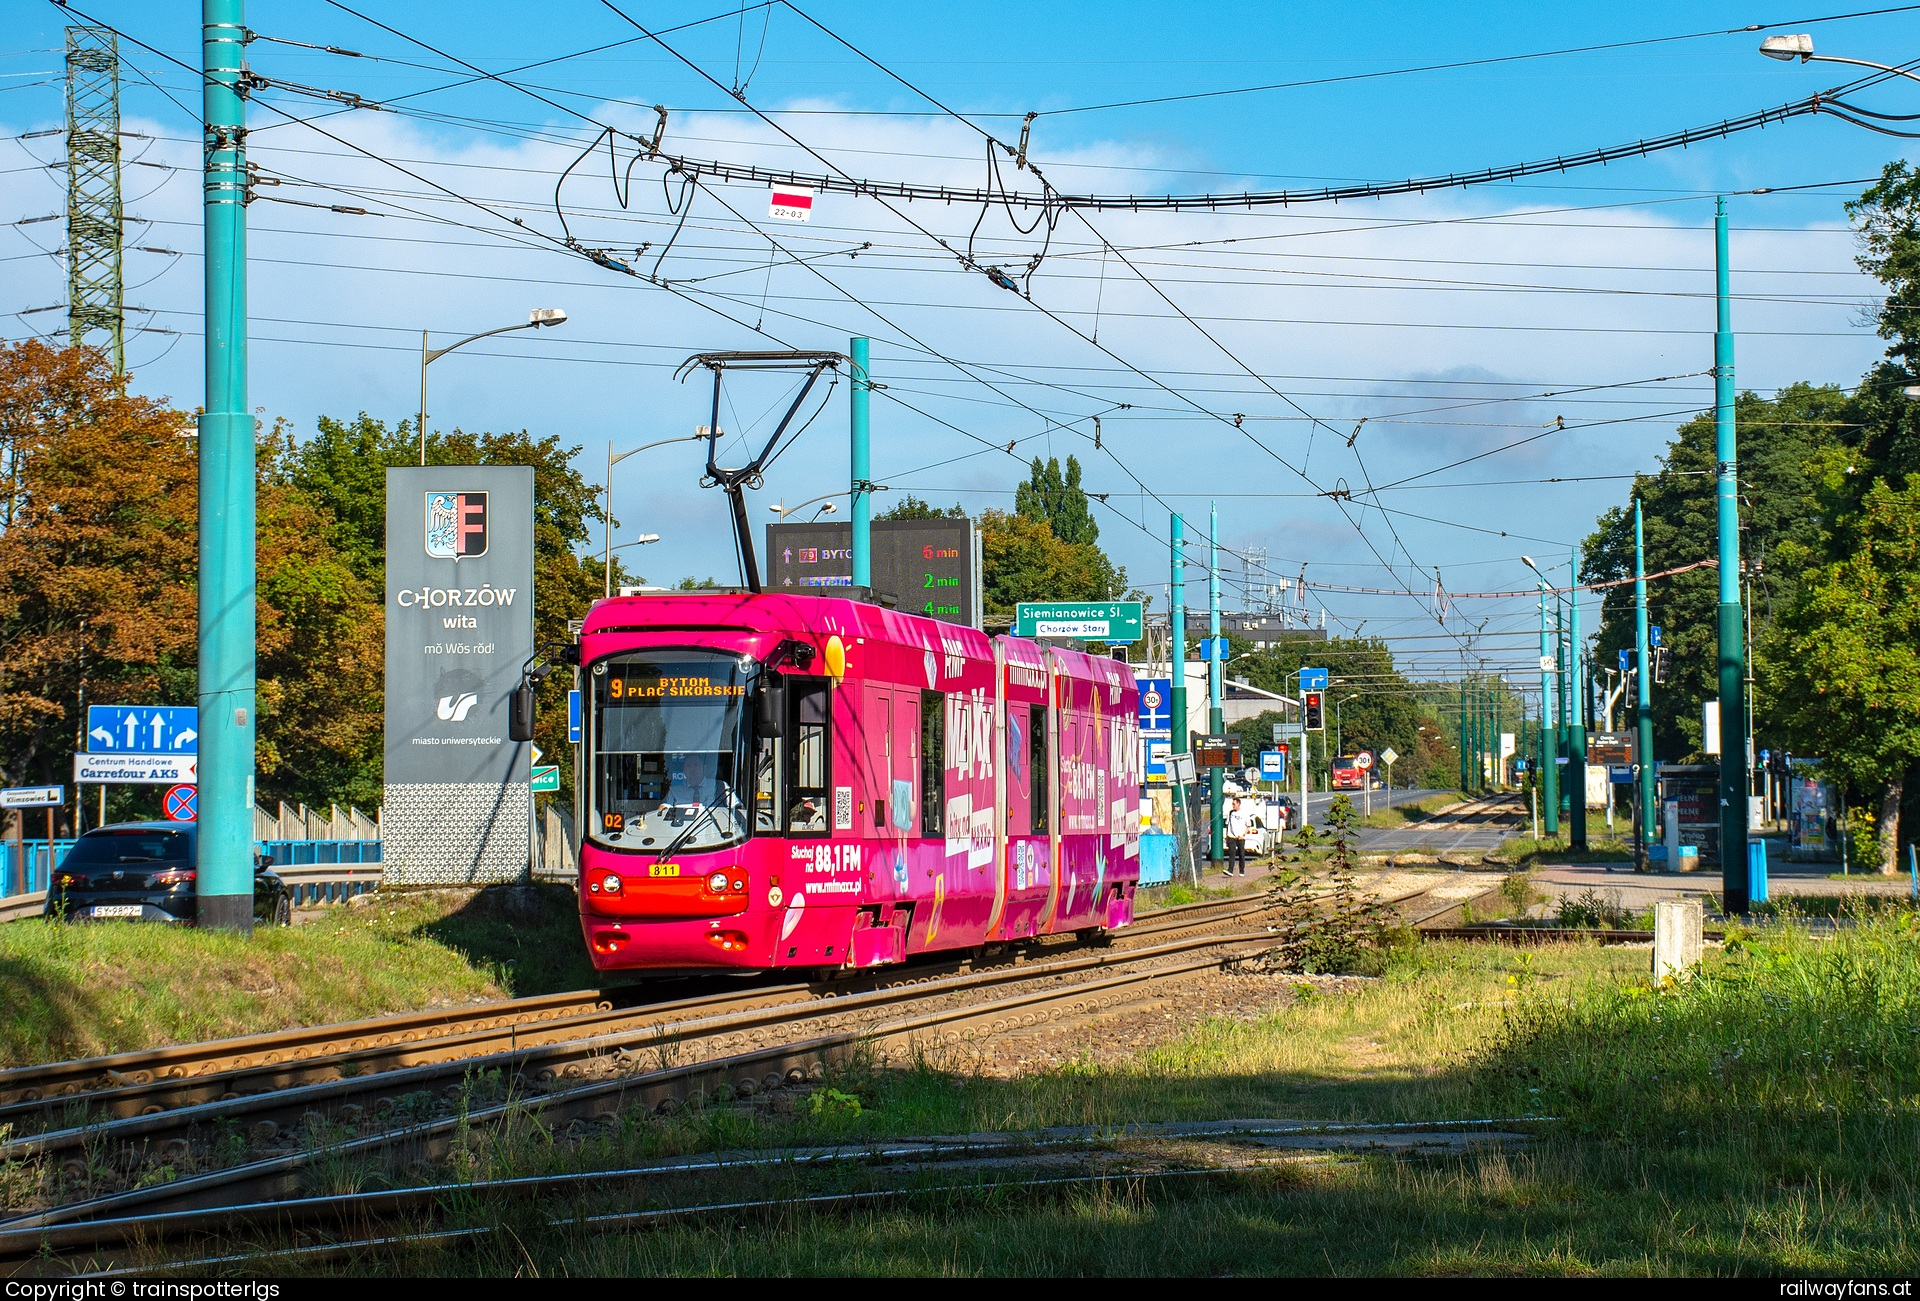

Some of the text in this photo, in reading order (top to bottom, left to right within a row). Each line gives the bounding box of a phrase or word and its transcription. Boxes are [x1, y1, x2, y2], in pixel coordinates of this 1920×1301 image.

[775, 208, 802, 218] 22-03
[922, 545, 958, 559] 6 min
[924, 573, 959, 588] 2 min
[924, 602, 959, 616] 4 min
[1023, 604, 1124, 618] Siemianowice Śl.
[443, 614, 478, 628] wita
[1040, 624, 1106, 634] Chorzów Stary
[611, 679, 623, 698] 9
[660, 678, 709, 687] BYTOM
[628, 686, 746, 696] PLAC SIKORSKIE
[412, 736, 502, 746] miasto uniwersyteckie
[88, 758, 172, 766] Centrum Handlowe
[80, 768, 178, 778] Carrefour AKS
[604, 814, 622, 828] 02
[805, 844, 861, 876] na 88,1 FM
[654, 866, 676, 876] 811
